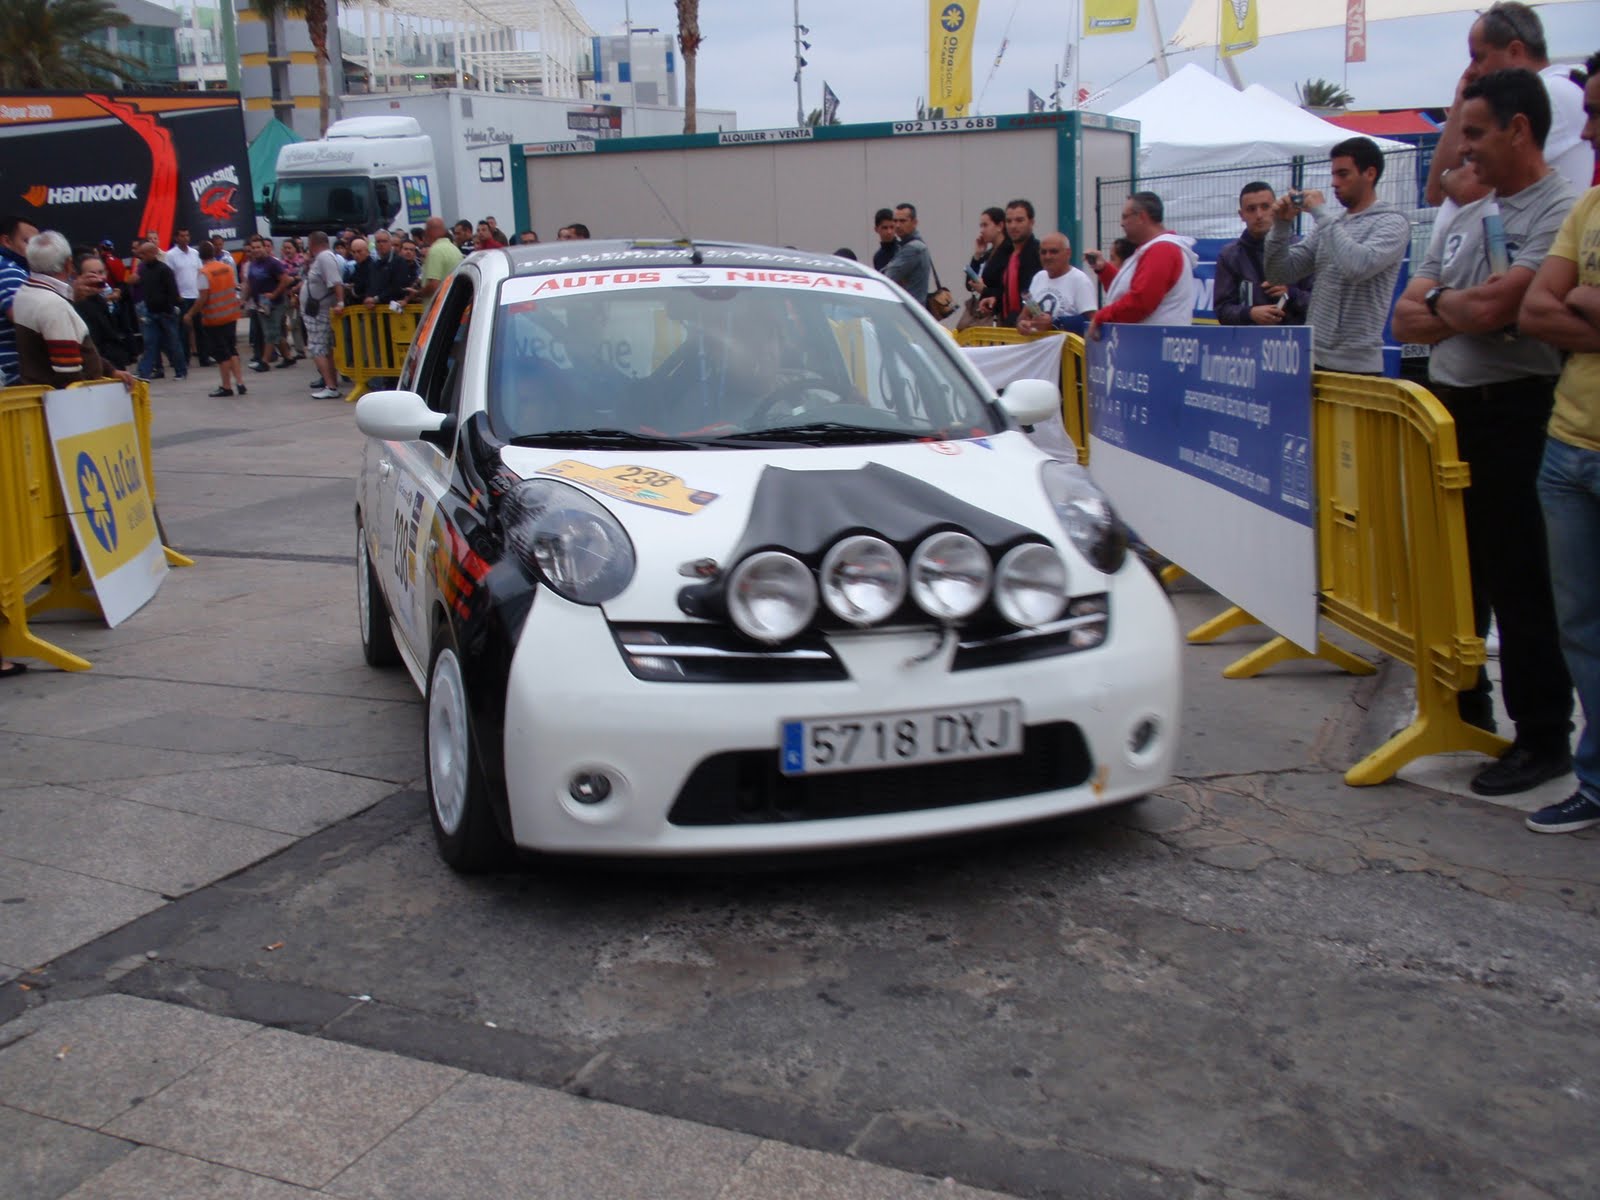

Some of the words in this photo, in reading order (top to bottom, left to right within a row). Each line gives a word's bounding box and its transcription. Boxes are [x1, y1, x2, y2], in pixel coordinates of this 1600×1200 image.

[720, 132, 766, 143] ALQUILER
[779, 129, 812, 139] VENTA
[894, 122, 923, 133] 902
[931, 120, 958, 131] 153
[966, 118, 996, 129] 688
[532, 271, 661, 297] AUTOS
[1162, 327, 1199, 373] imagen
[1201, 344, 1257, 389] iluminación
[1261, 328, 1300, 376] sonido
[613, 465, 678, 488] 238
[393, 507, 410, 593] 238
[811, 718, 918, 766] 5718
[932, 707, 1012, 755] DXJ
